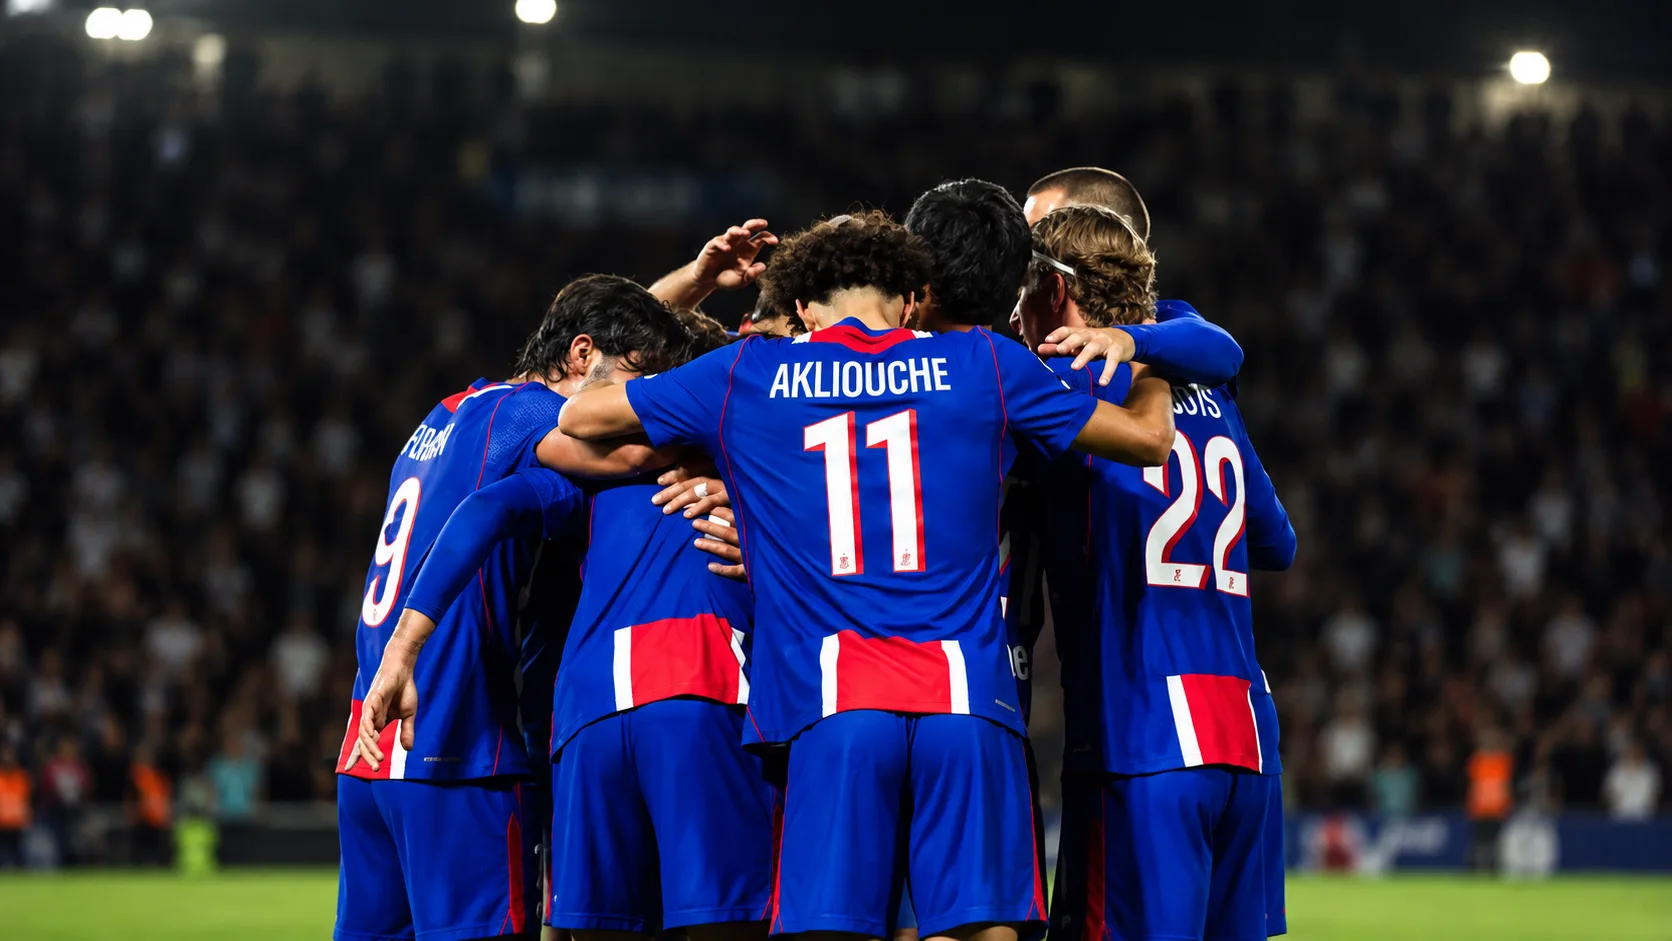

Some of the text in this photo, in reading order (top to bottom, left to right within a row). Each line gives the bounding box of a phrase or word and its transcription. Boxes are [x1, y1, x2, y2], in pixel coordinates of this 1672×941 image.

[769, 357, 951, 398] AKLIOUCHE
[361, 476, 421, 628] 9
[803, 408, 926, 576] 11
[1142, 429, 1250, 598] 22
